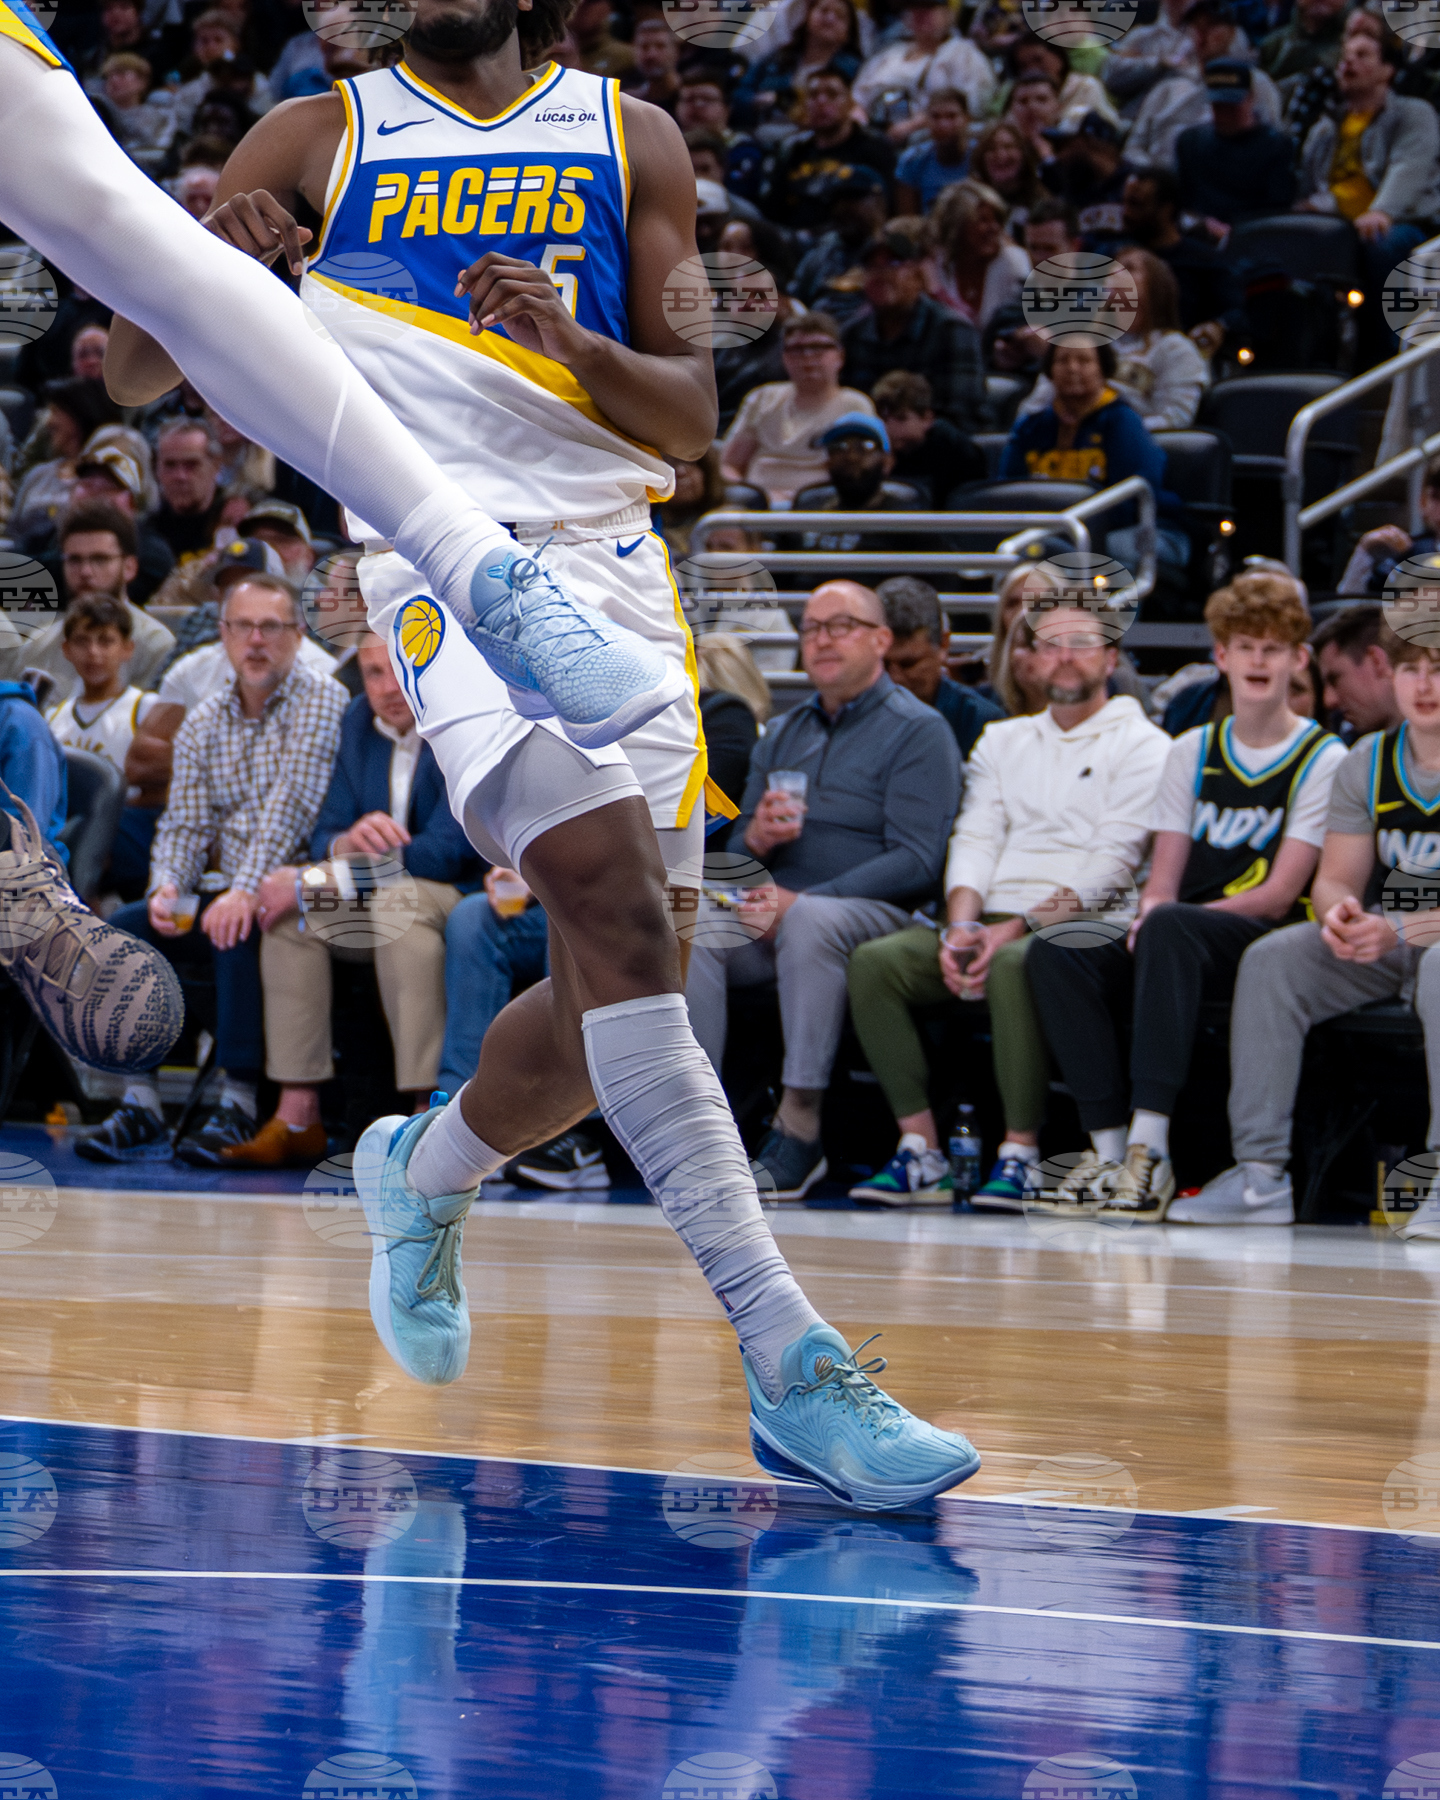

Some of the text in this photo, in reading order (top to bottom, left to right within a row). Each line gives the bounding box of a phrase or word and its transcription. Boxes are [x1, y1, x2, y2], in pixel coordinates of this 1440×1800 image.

[534, 111, 598, 123] LUCAS OIL
[368, 164, 594, 243] PACERS
